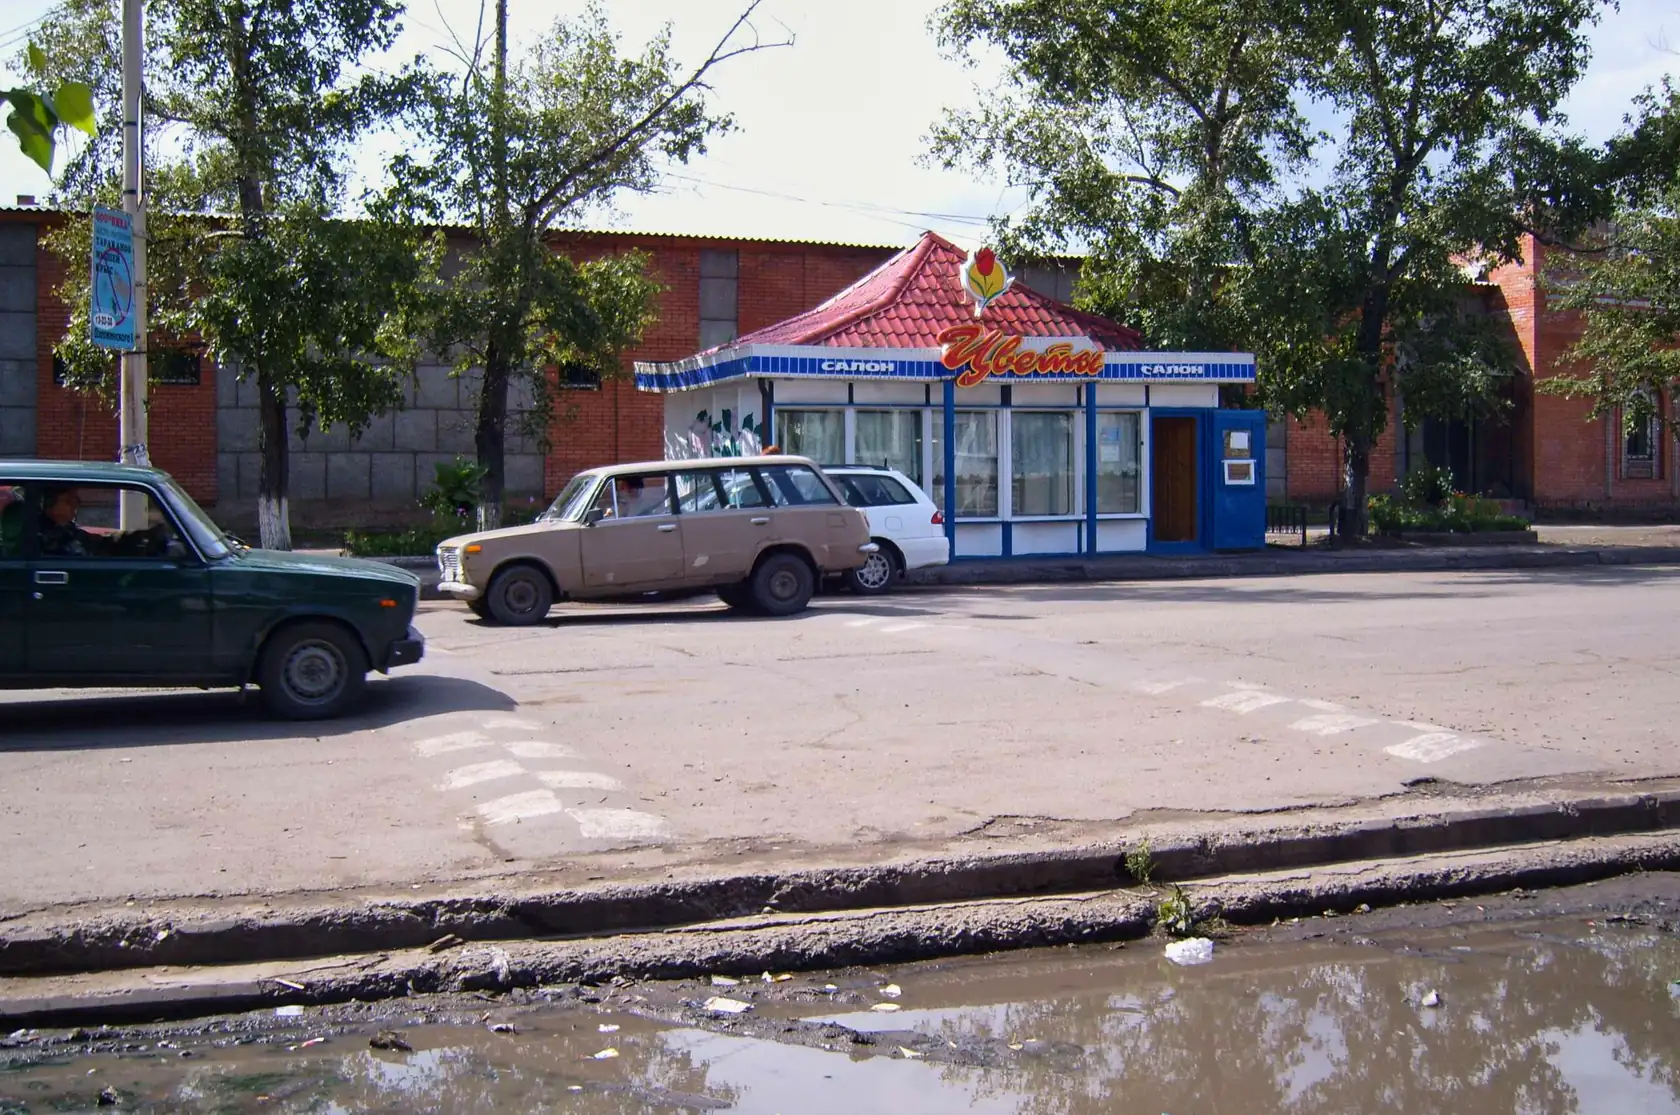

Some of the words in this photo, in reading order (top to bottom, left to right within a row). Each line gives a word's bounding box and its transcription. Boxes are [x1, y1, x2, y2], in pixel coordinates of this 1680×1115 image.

[936, 324, 1105, 388] Цветы
[820, 361, 895, 373] САЛОН
[1140, 365, 1204, 376] САЛОН
